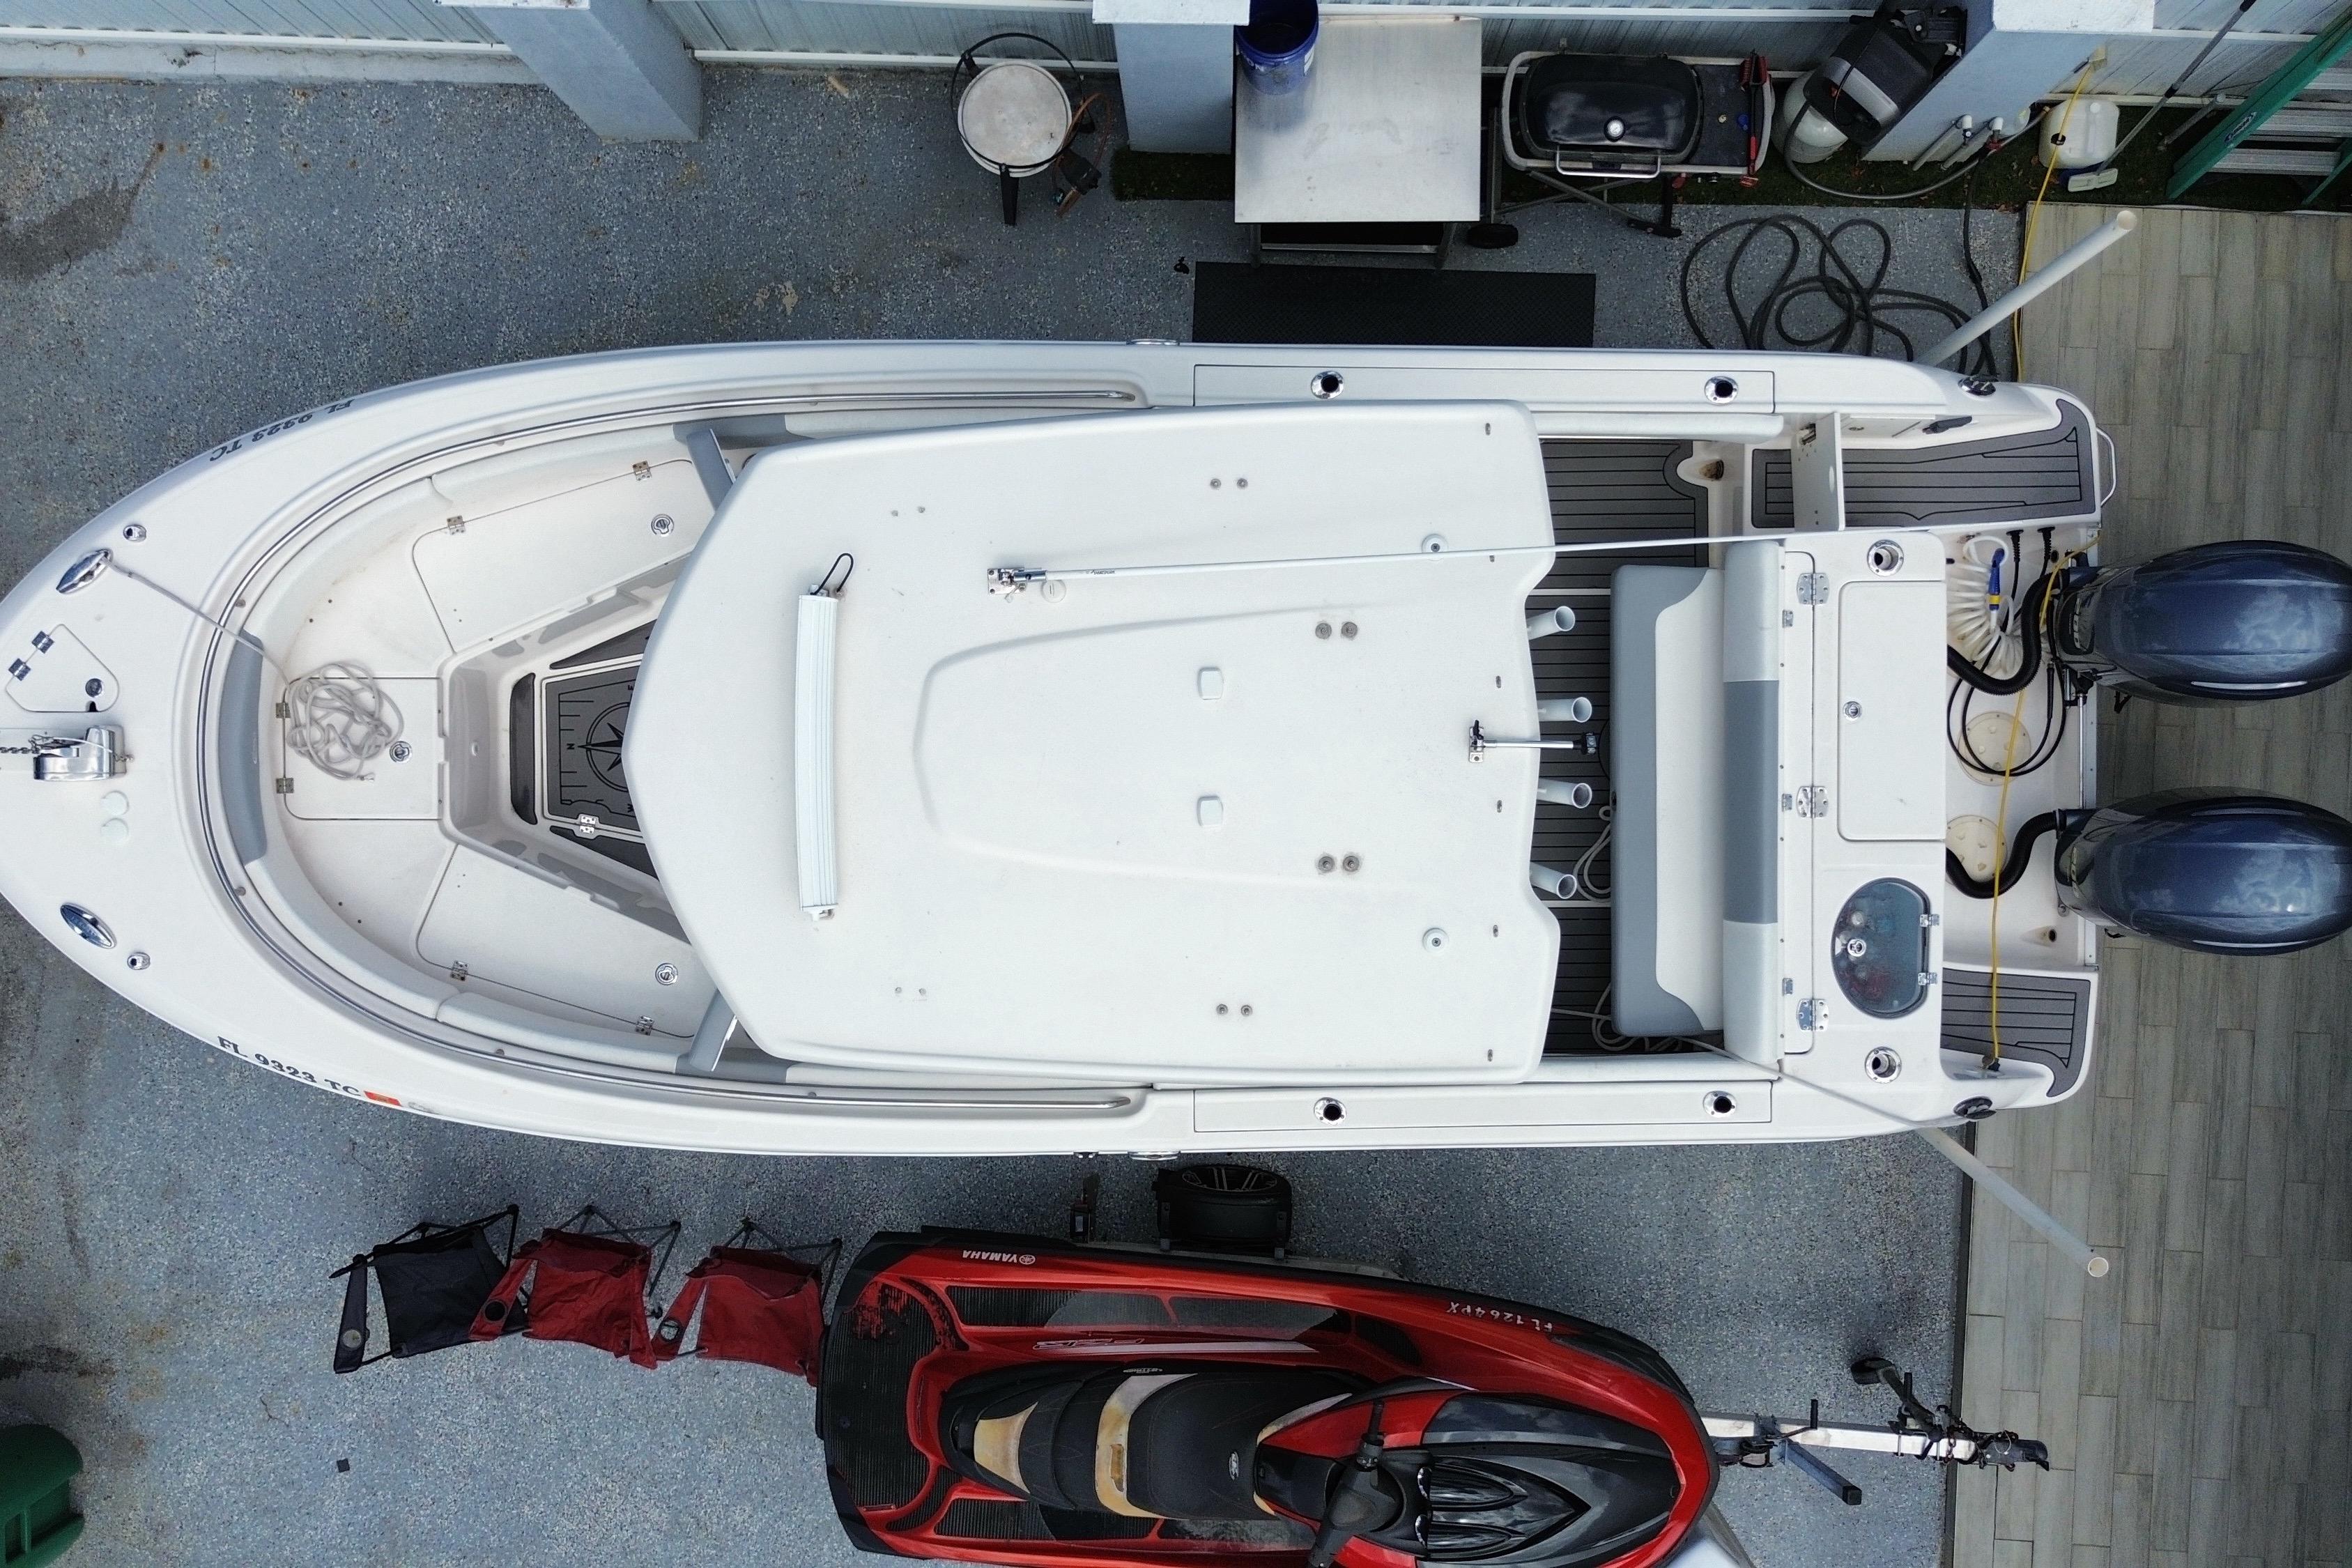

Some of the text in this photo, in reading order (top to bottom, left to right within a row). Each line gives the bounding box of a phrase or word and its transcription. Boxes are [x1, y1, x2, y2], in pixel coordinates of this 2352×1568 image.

[210, 399, 355, 461] FL 9323 TC
[217, 1036, 362, 1097] FL 9323 TC
[962, 1250, 1017, 1263] YAMAHA
